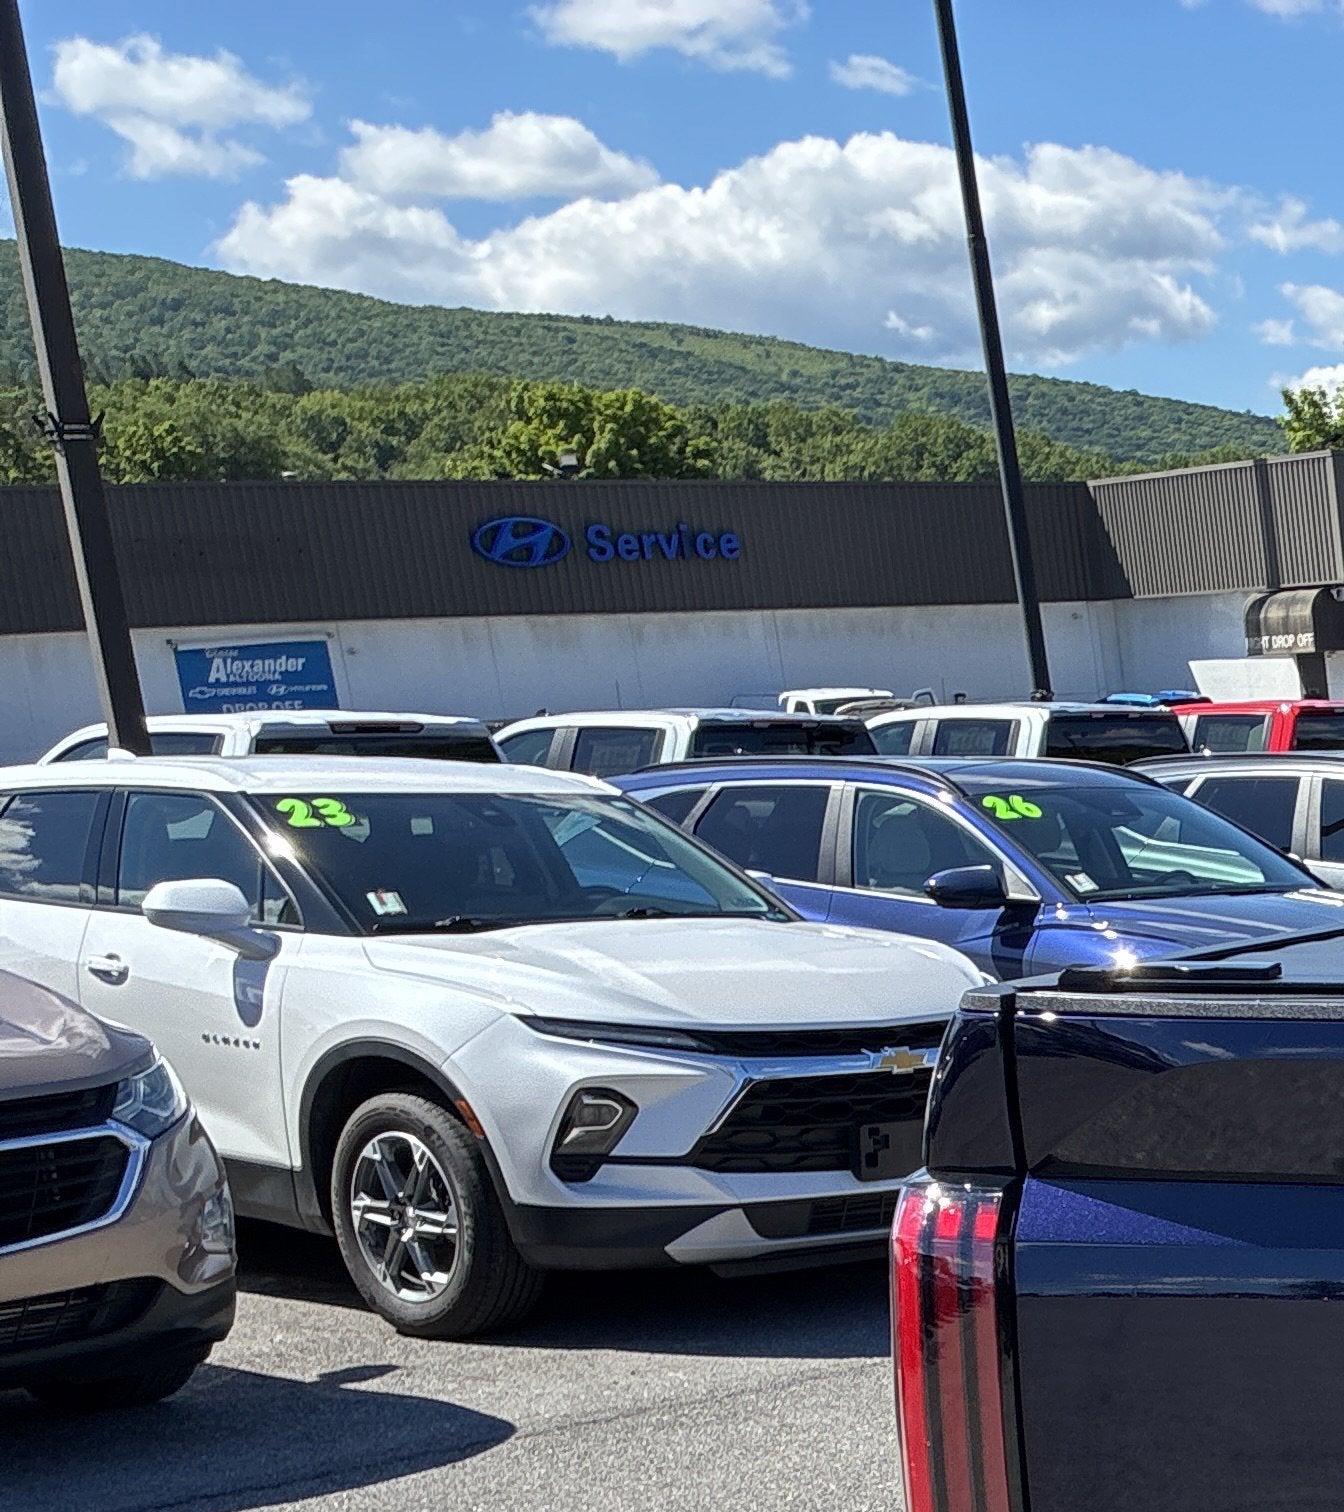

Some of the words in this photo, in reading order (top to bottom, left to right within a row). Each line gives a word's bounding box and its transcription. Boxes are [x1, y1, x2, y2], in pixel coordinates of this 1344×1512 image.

[586, 521, 741, 562] Service
[1271, 634, 1295, 649] DROP
[1296, 632, 1315, 648] OFF
[208, 655, 306, 684] Alexander
[275, 798, 356, 827] 23
[982, 795, 1043, 819] 26
